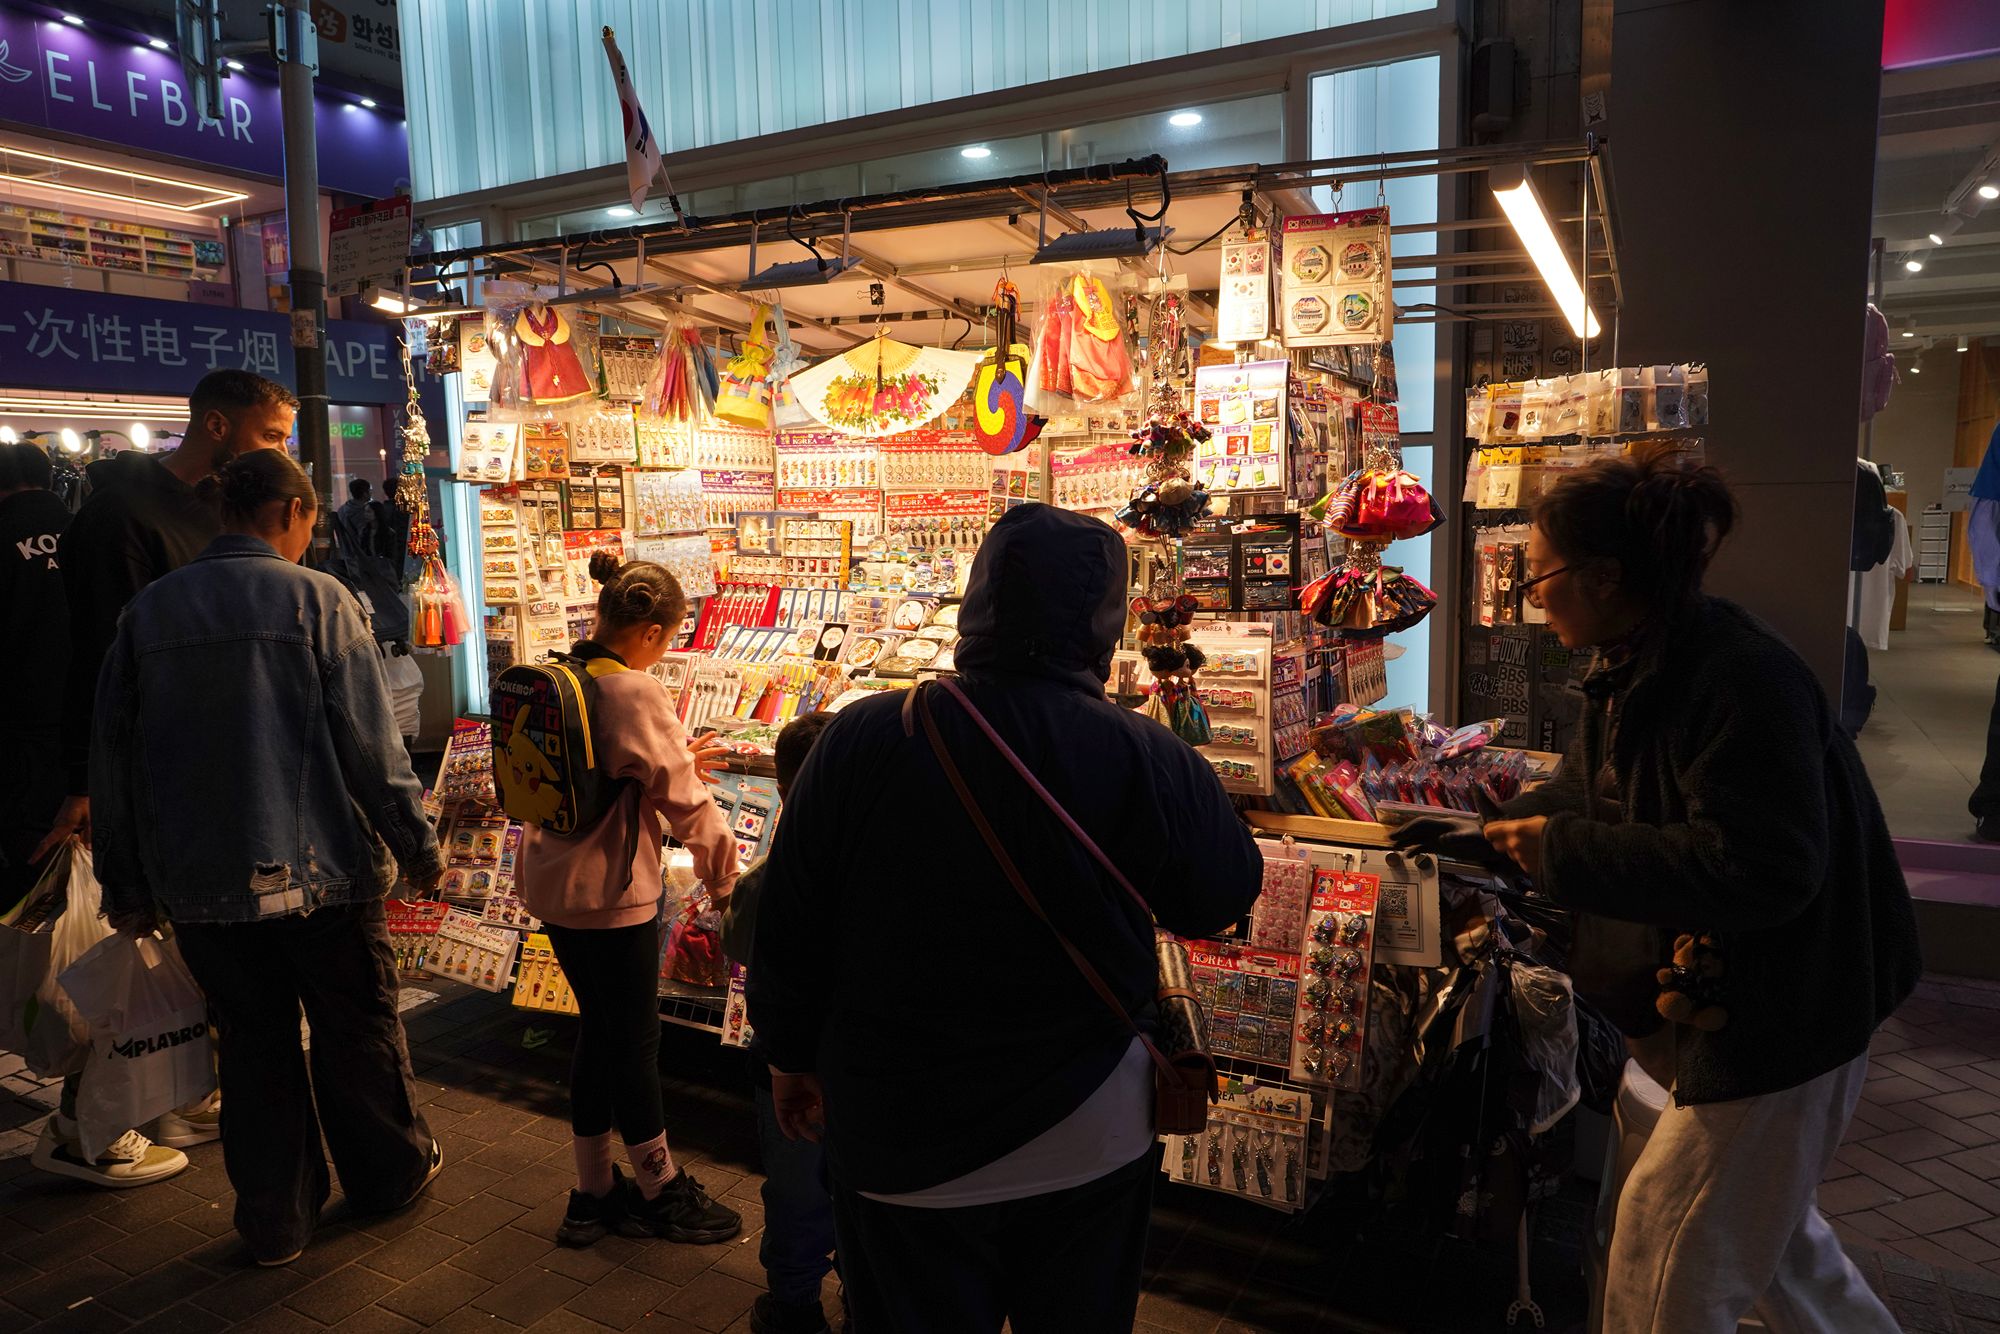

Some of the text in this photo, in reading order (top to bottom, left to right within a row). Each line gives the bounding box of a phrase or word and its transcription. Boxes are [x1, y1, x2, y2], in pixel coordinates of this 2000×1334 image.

[409, 320, 428, 329] VAPE
[325, 340, 390, 380] APE
[392, 409, 403, 449] VAPE
[792, 438, 818, 446] KOREA
[894, 435, 922, 443] KOREA
[1247, 558, 1252, 567] I
[529, 602, 561, 616] KOREA
[1499, 666, 1527, 684] BBS
[1498, 682, 1525, 698] BBS
[1501, 698, 1529, 714] BBS
[1191, 953, 1234, 969] KOREA
[132, 1022, 208, 1058] PLAYRO
[1216, 1089, 1236, 1102] REA
